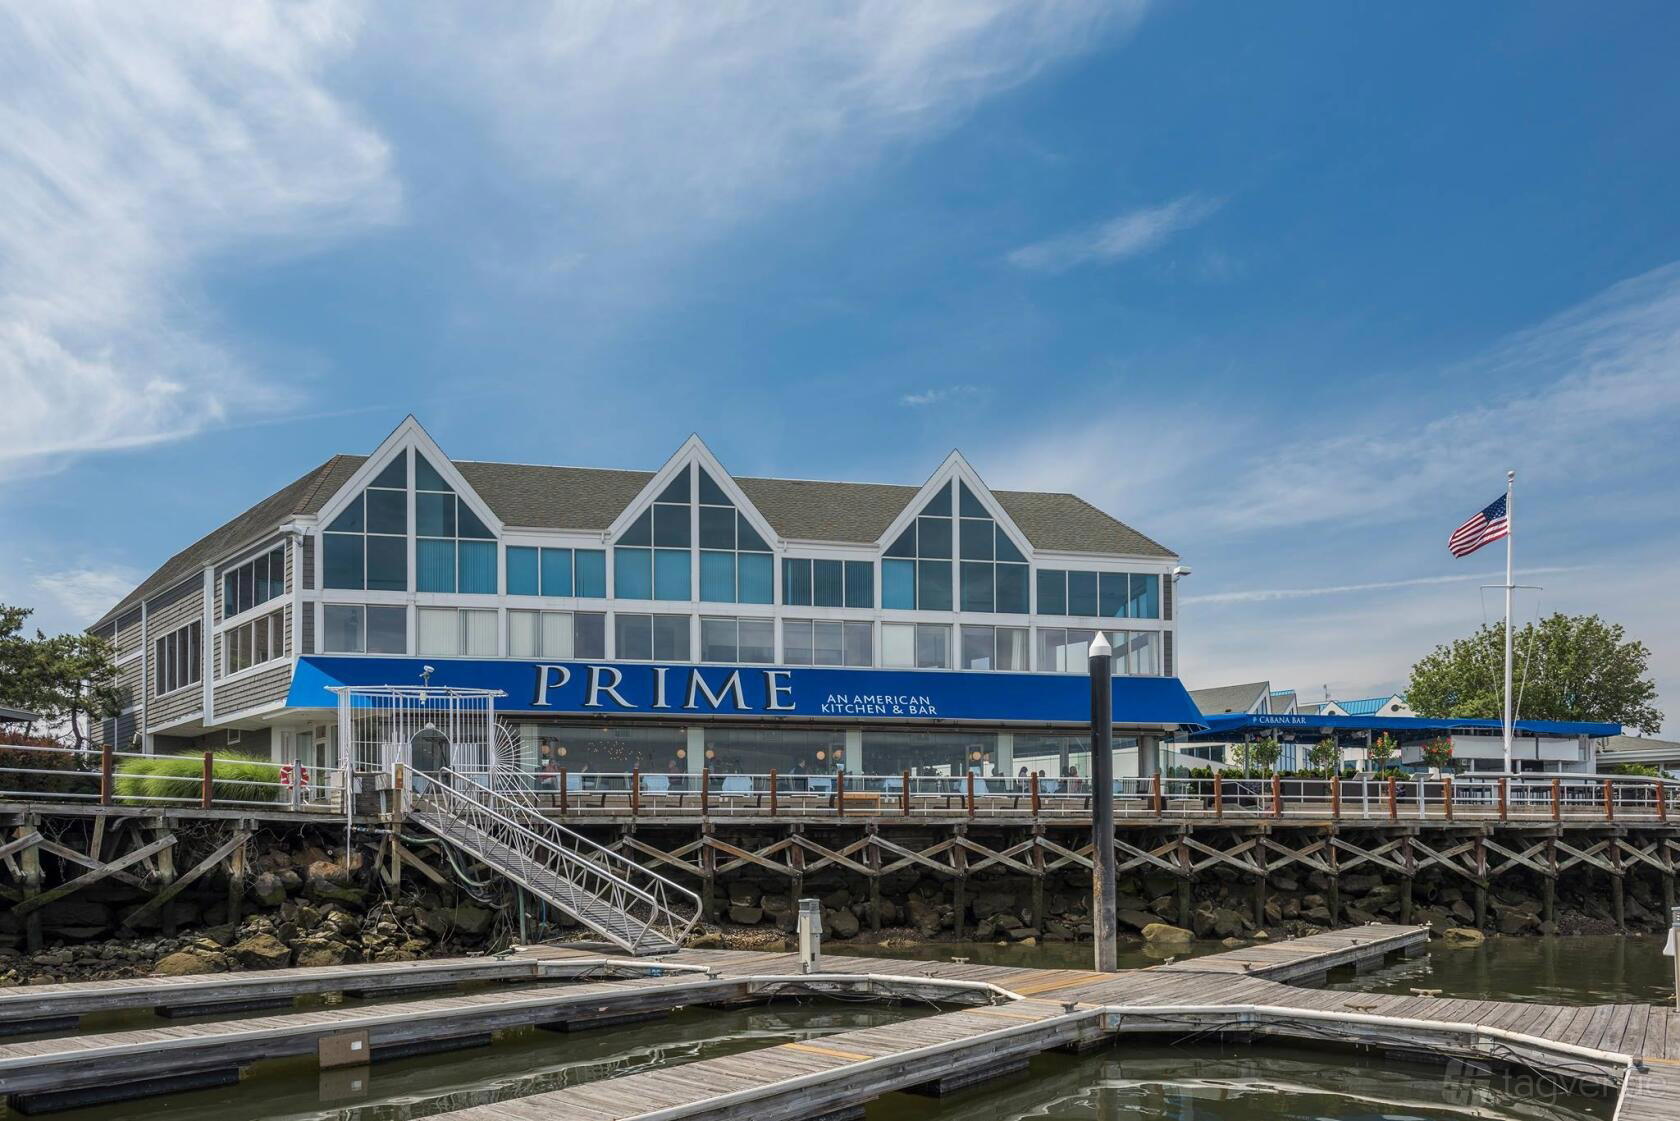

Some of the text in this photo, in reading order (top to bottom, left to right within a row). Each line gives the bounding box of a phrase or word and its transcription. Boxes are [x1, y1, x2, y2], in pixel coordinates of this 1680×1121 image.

[533, 664, 796, 711] PRIME
[827, 694, 931, 705] AN AMERICAN
[821, 704, 938, 715] KITCHEN & BAR
[1259, 716, 1291, 724] CABANA
[1291, 716, 1306, 725] BAR
